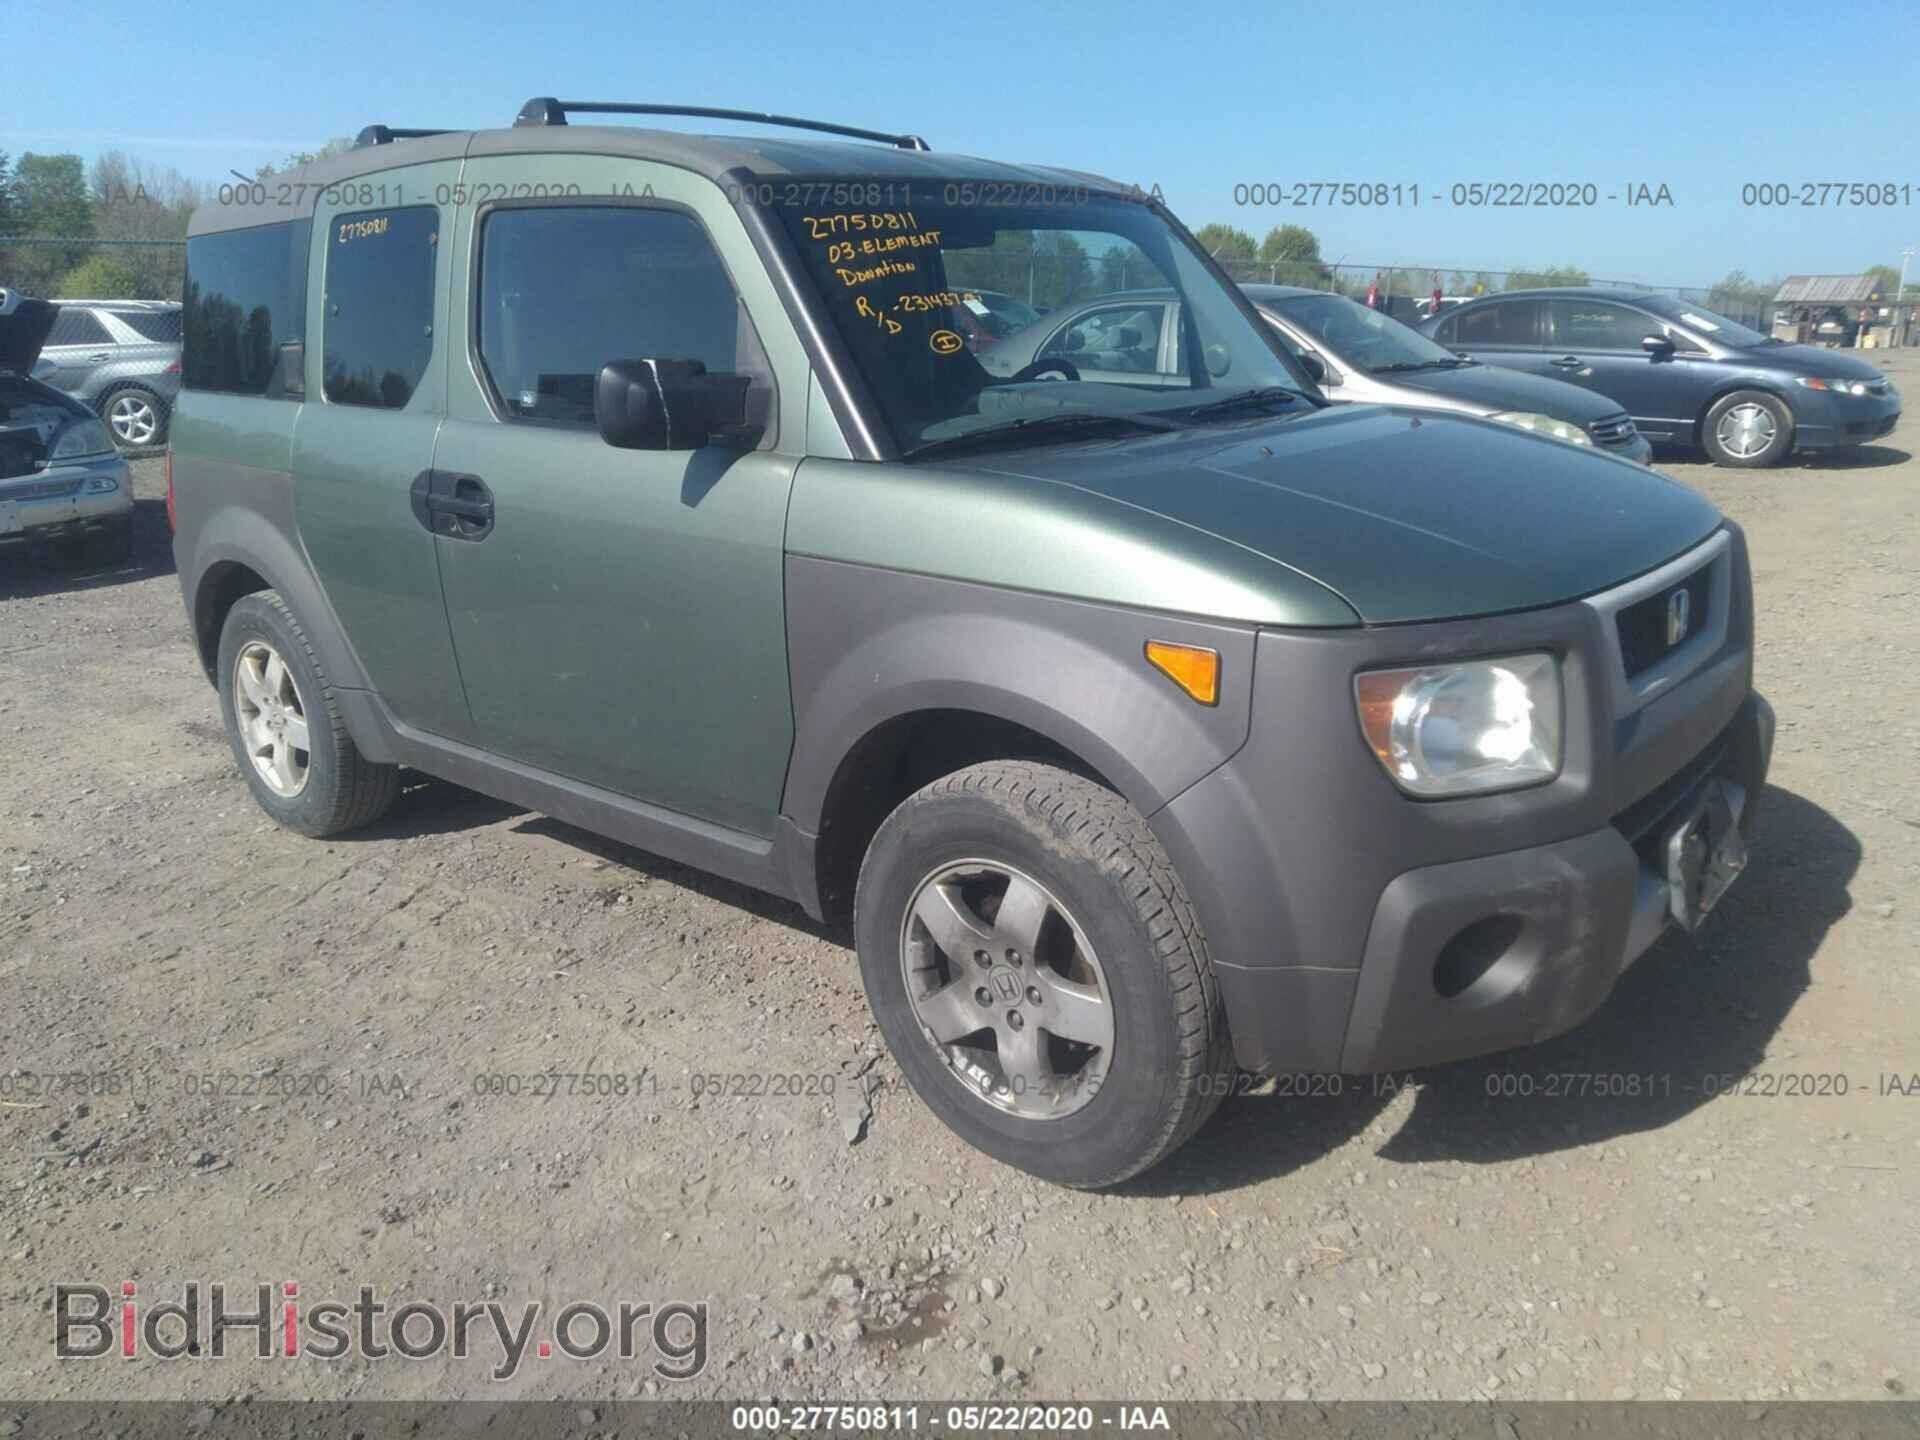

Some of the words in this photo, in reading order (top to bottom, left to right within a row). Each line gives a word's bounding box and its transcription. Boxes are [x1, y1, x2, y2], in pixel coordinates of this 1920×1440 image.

[338, 217, 388, 243] 27750811
[803, 212, 918, 239] 27750811
[829, 232, 941, 263] 03-ELEMENT
